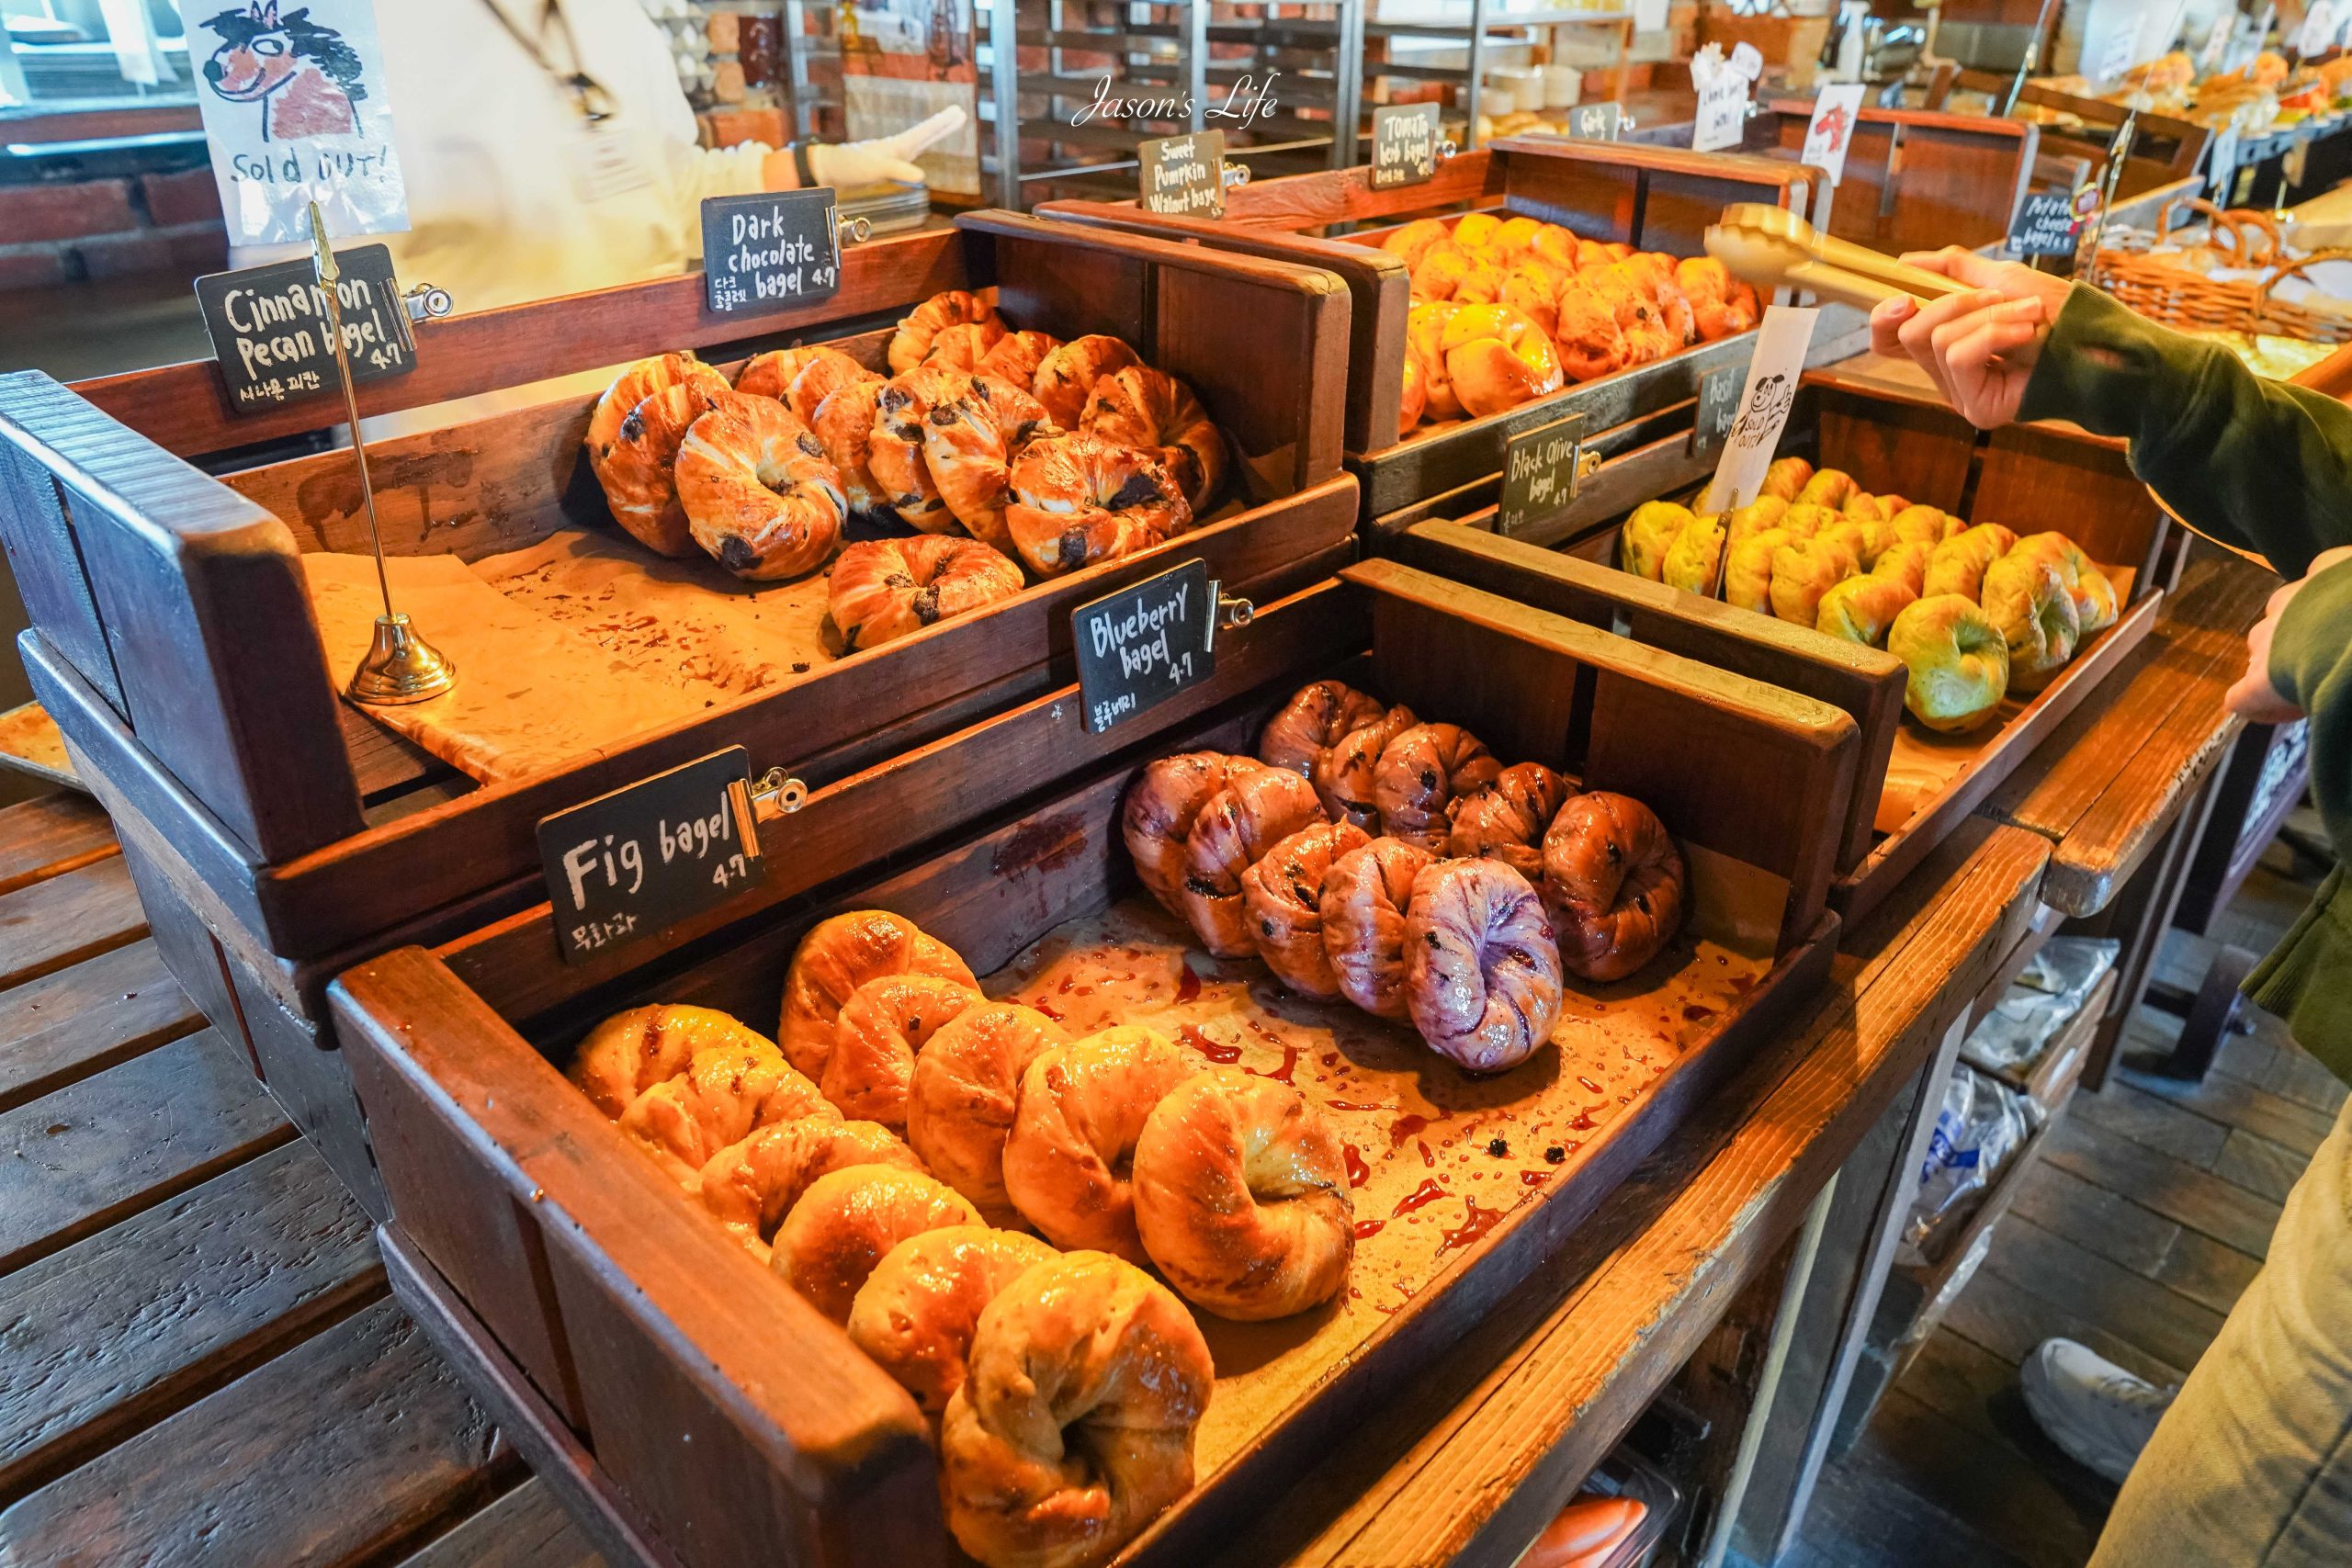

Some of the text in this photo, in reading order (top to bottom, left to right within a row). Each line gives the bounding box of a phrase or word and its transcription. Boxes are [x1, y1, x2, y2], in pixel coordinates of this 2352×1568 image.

[231, 147, 301, 183] Sold
[1161, 137, 1195, 162] Sweet
[1154, 162, 1206, 191] Pumpkin
[1148, 191, 1190, 213] Walnut
[732, 206, 784, 245] Dark
[728, 234, 815, 273] chocolate
[715, 276, 736, 289] 다크
[755, 266, 835, 299] bagel 4.7
[236, 330, 316, 380] Pecan
[287, 370, 320, 389] 피칸
[1511, 437, 1573, 482] Black Olive
[1529, 467, 1555, 503] bagel
[1120, 629, 1170, 679] bagel
[1169, 652, 1193, 685] 4.7
[562, 791, 729, 910] Fig bagel
[712, 853, 746, 888] 4.7
